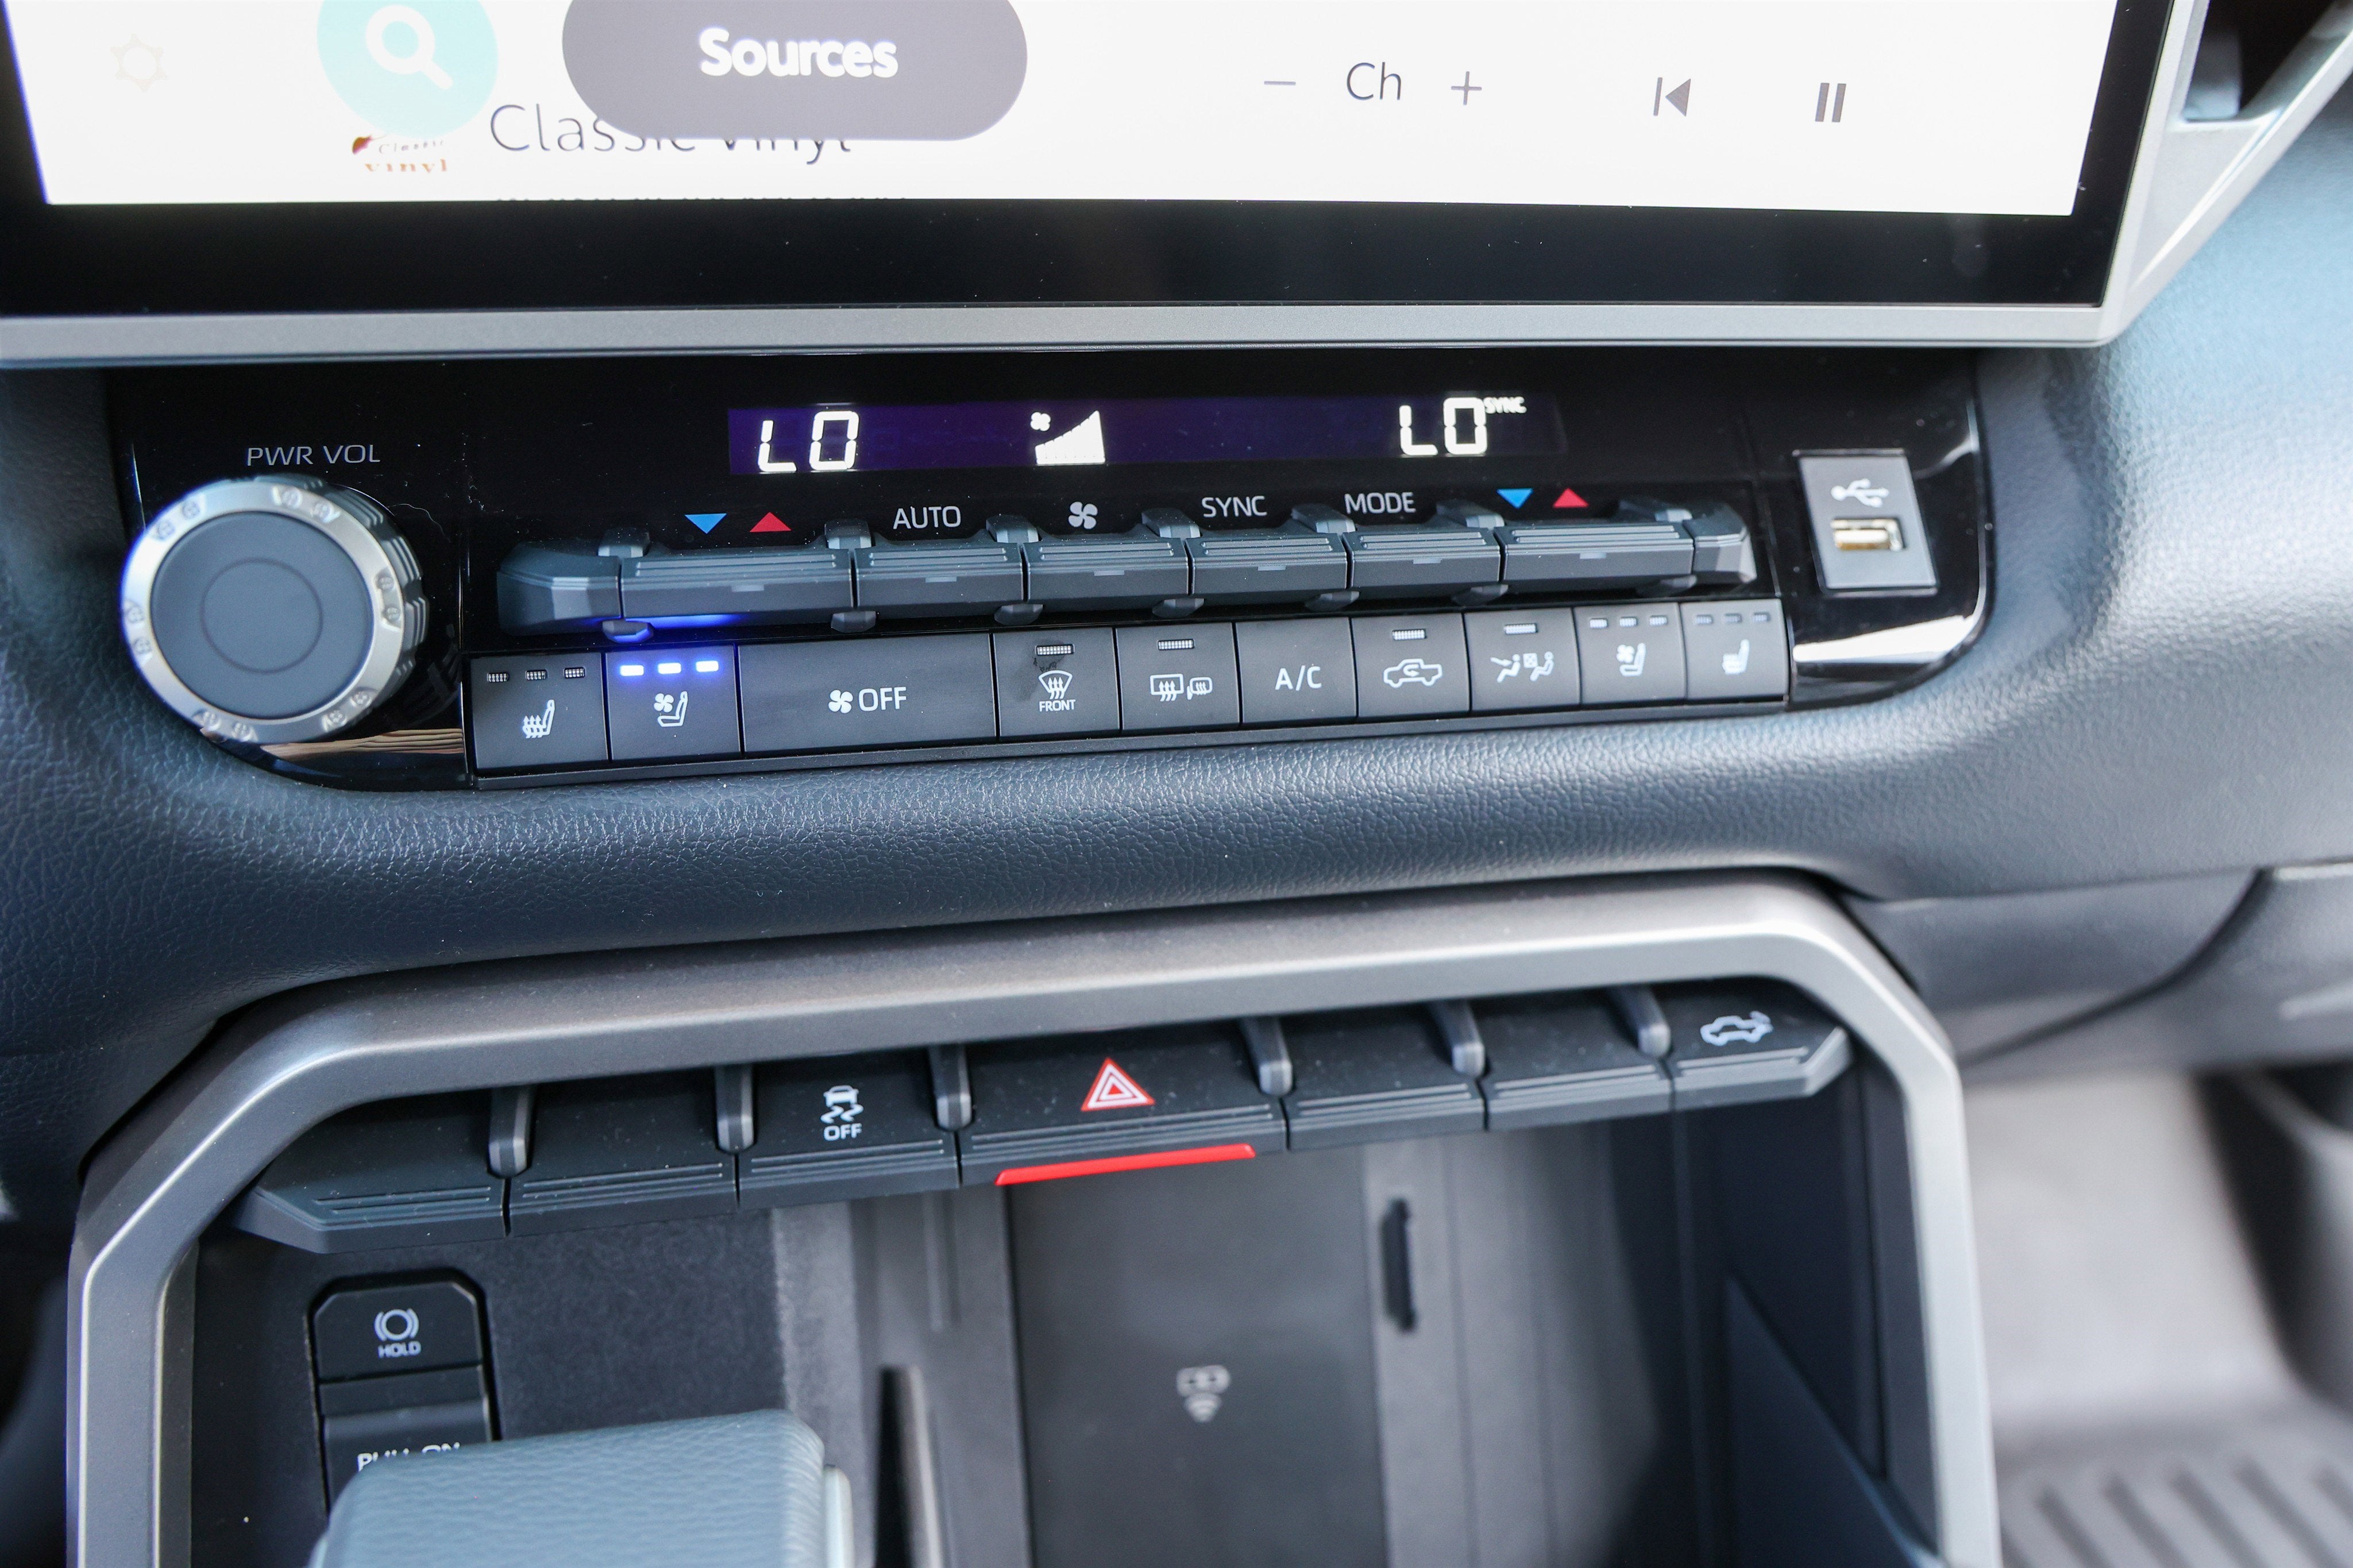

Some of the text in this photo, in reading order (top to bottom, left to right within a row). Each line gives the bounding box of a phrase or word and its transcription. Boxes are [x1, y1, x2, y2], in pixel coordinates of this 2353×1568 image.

[699, 27, 898, 78] Sources
[1346, 61, 1402, 101] Ch
[1483, 396, 1527, 414] SYNC
[246, 444, 381, 466] PWR VOL
[1201, 495, 1268, 518] SYNC
[1344, 492, 1416, 514] MODE
[892, 505, 962, 530] AUTO
[1275, 665, 1322, 691] A/C
[858, 686, 907, 712] OFF
[1039, 699, 1077, 712] FRONT
[823, 1122, 863, 1142] OFF
[378, 1341, 422, 1358] HOLD
